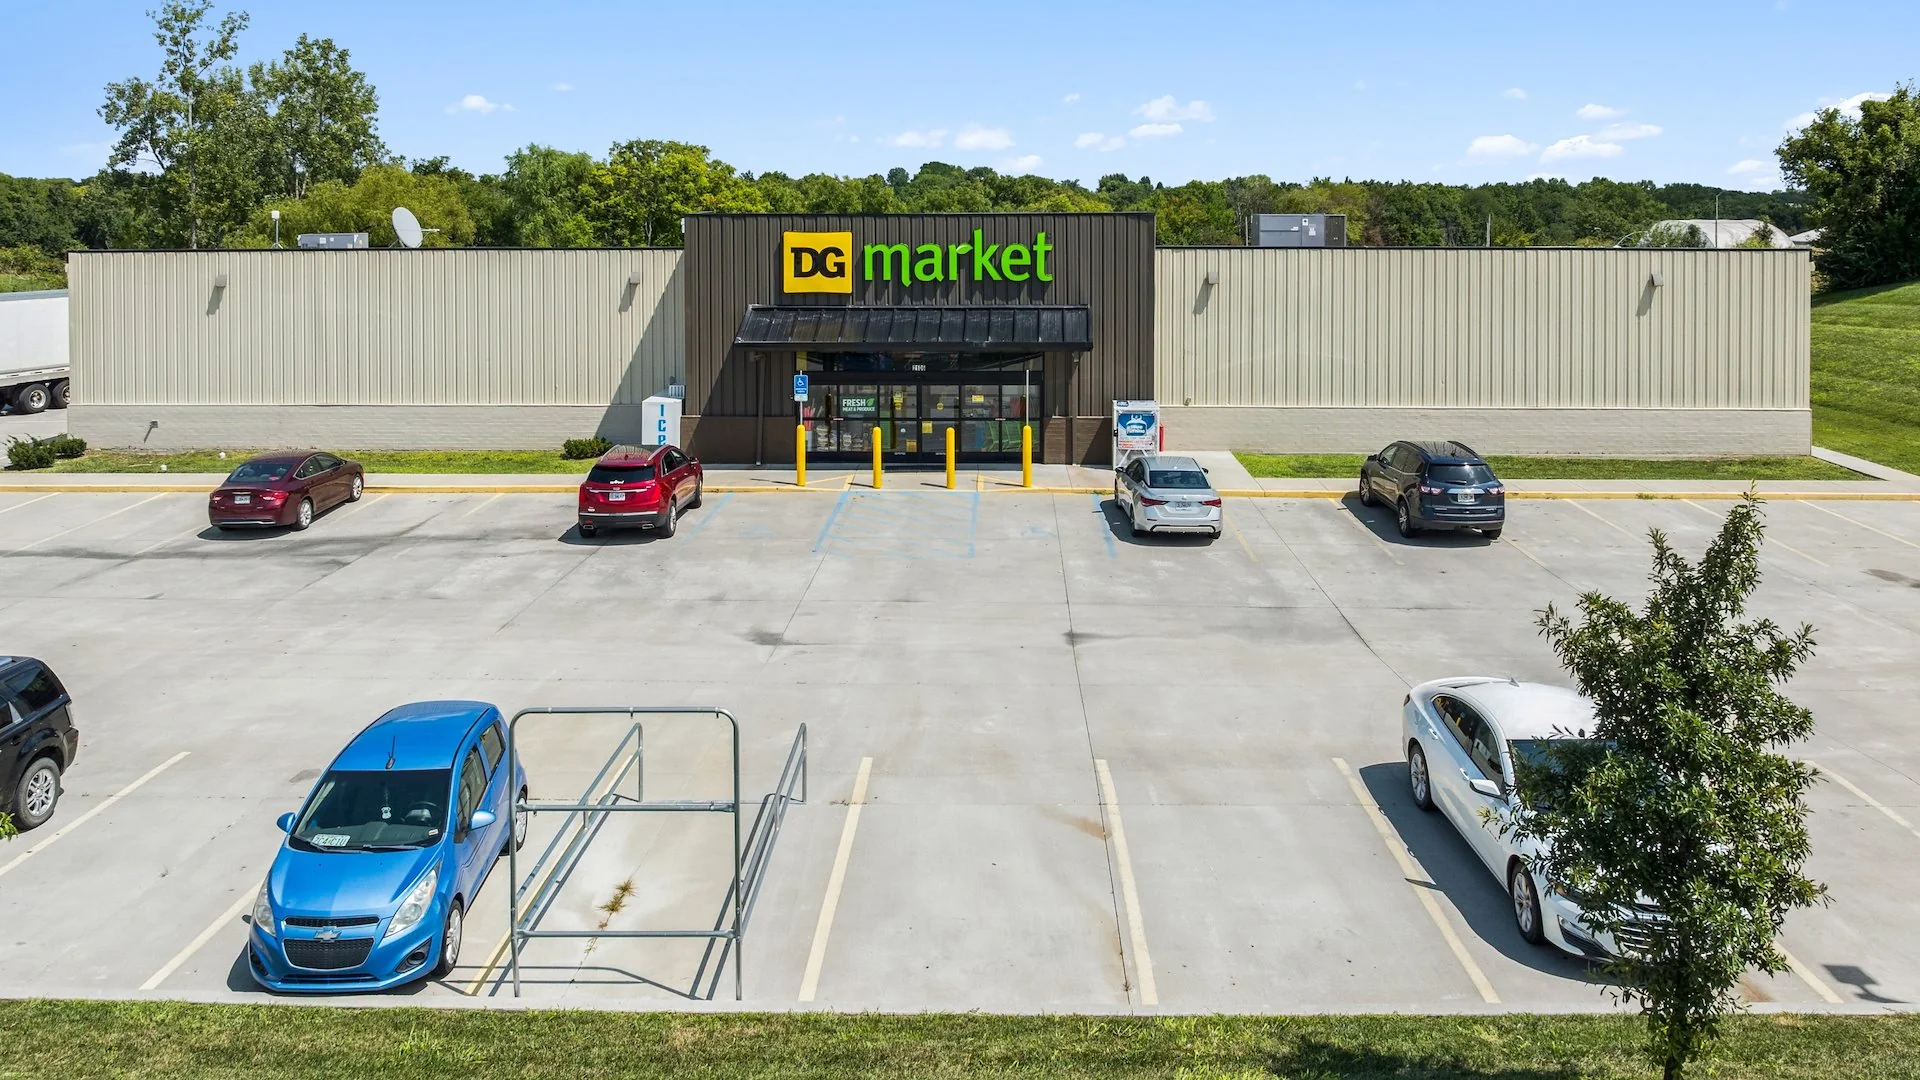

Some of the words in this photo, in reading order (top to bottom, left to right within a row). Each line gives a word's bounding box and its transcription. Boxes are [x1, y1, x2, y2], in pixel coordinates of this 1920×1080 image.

[790, 246, 846, 278] DG
[863, 229, 1053, 287] market
[842, 398, 866, 406] FRESH
